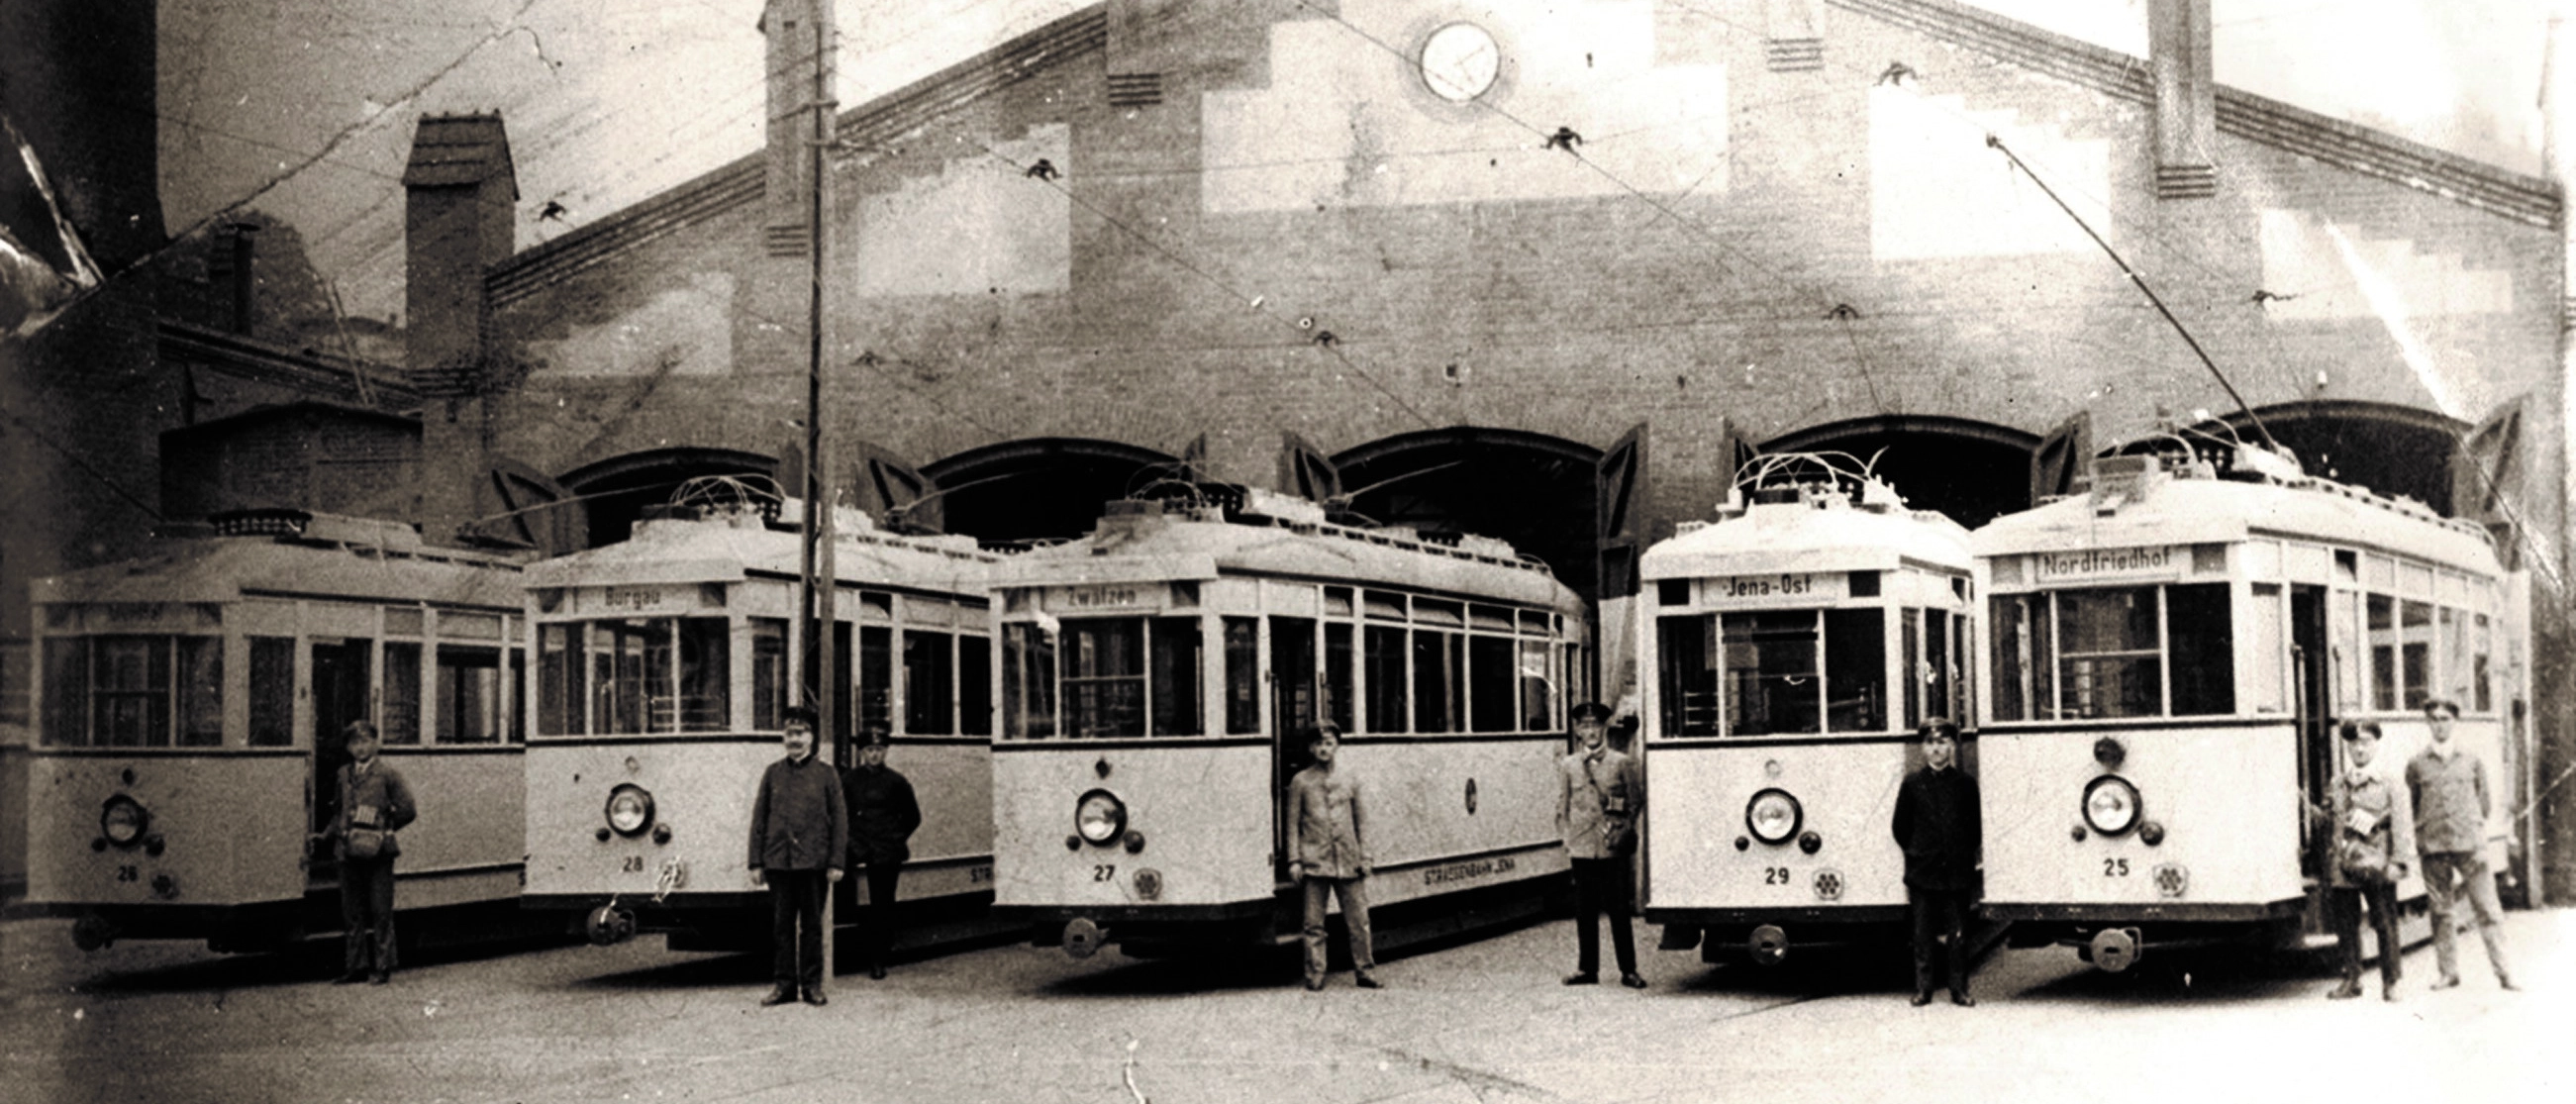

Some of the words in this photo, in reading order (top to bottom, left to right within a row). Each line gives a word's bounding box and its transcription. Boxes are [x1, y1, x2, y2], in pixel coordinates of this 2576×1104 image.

[2043, 546, 2170, 574] Nordfriedhof
[1727, 573, 1811, 597] Jena-Ost
[605, 585, 661, 611] Burgau
[624, 855, 644, 872] 28
[1093, 864, 1116, 882] 27
[2103, 857, 2130, 876] 25
[1765, 866, 1790, 885] 29
